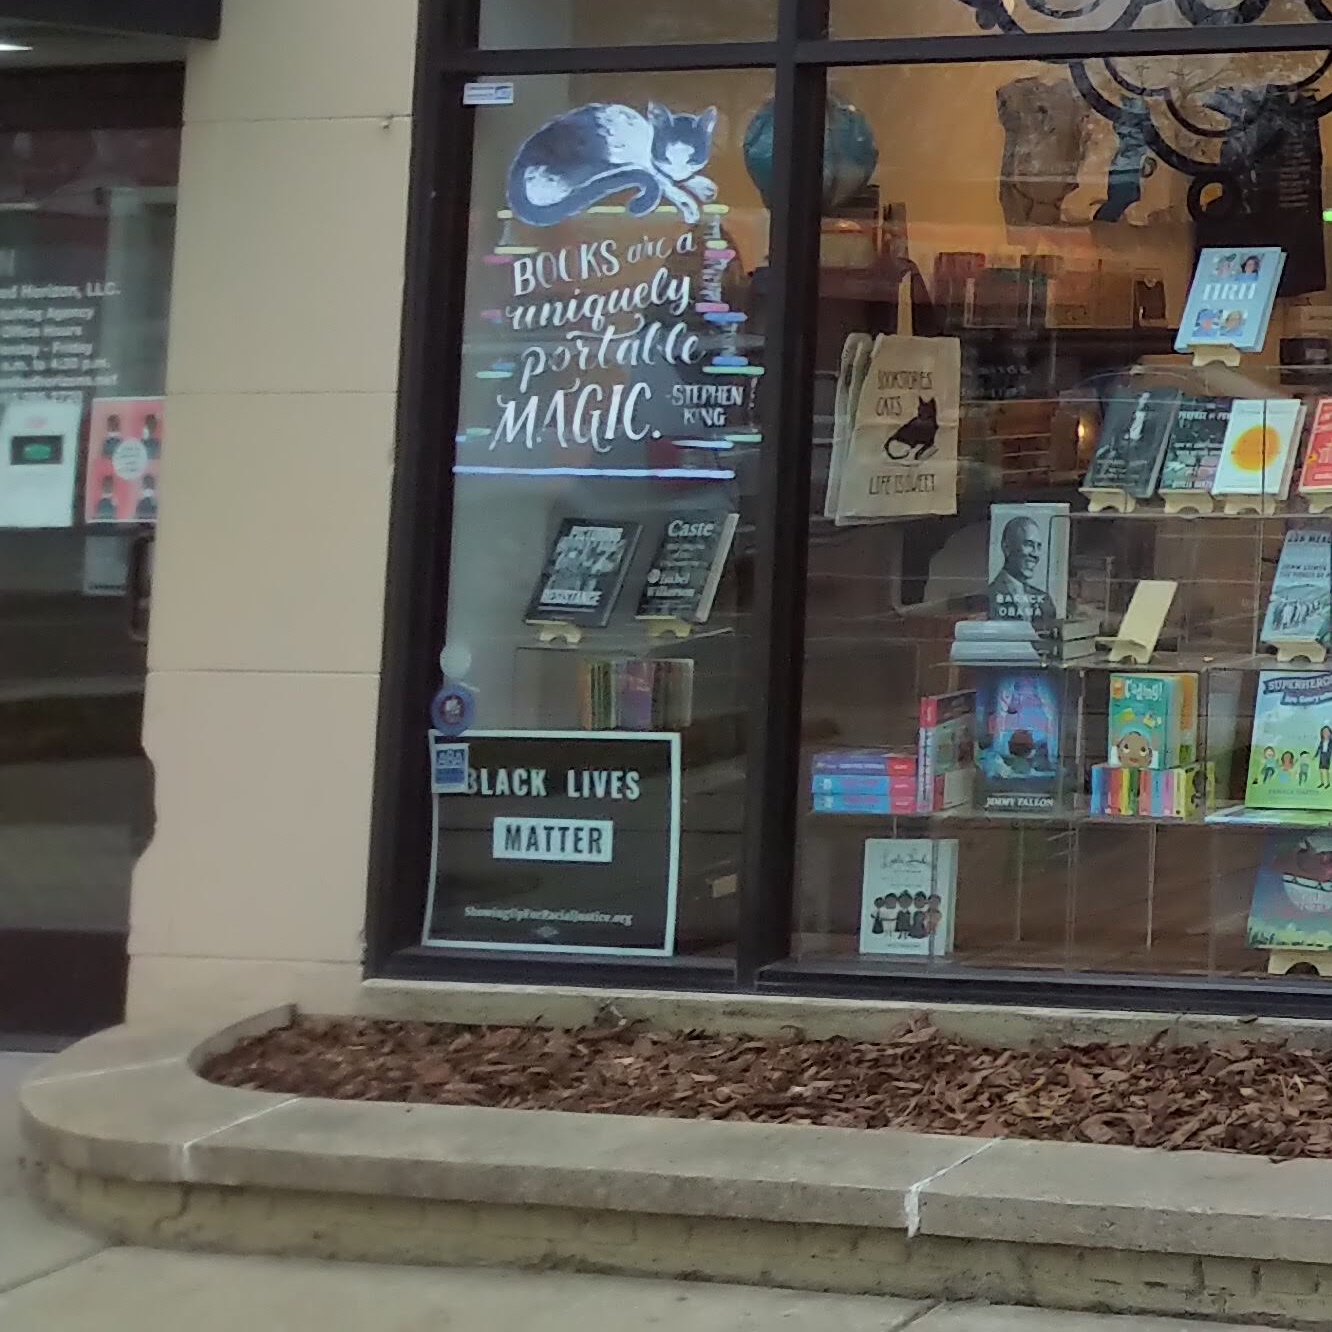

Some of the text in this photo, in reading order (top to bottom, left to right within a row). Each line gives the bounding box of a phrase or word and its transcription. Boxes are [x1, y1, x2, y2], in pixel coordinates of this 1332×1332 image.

[675, 230, 697, 254] a
[505, 267, 692, 331] uniquely
[519, 313, 707, 394] portable
[488, 378, 662, 454] MAGIC.
[682, 406, 728, 427] KING
[875, 395, 903, 416] CATS
[667, 519, 716, 537] Caste
[996, 593, 1046, 604] BARACK
[998, 606, 1042, 617] OBAMA
[465, 767, 547, 798] BLACK
[566, 768, 641, 800] LIVES
[504, 823, 603, 855] MATTER
